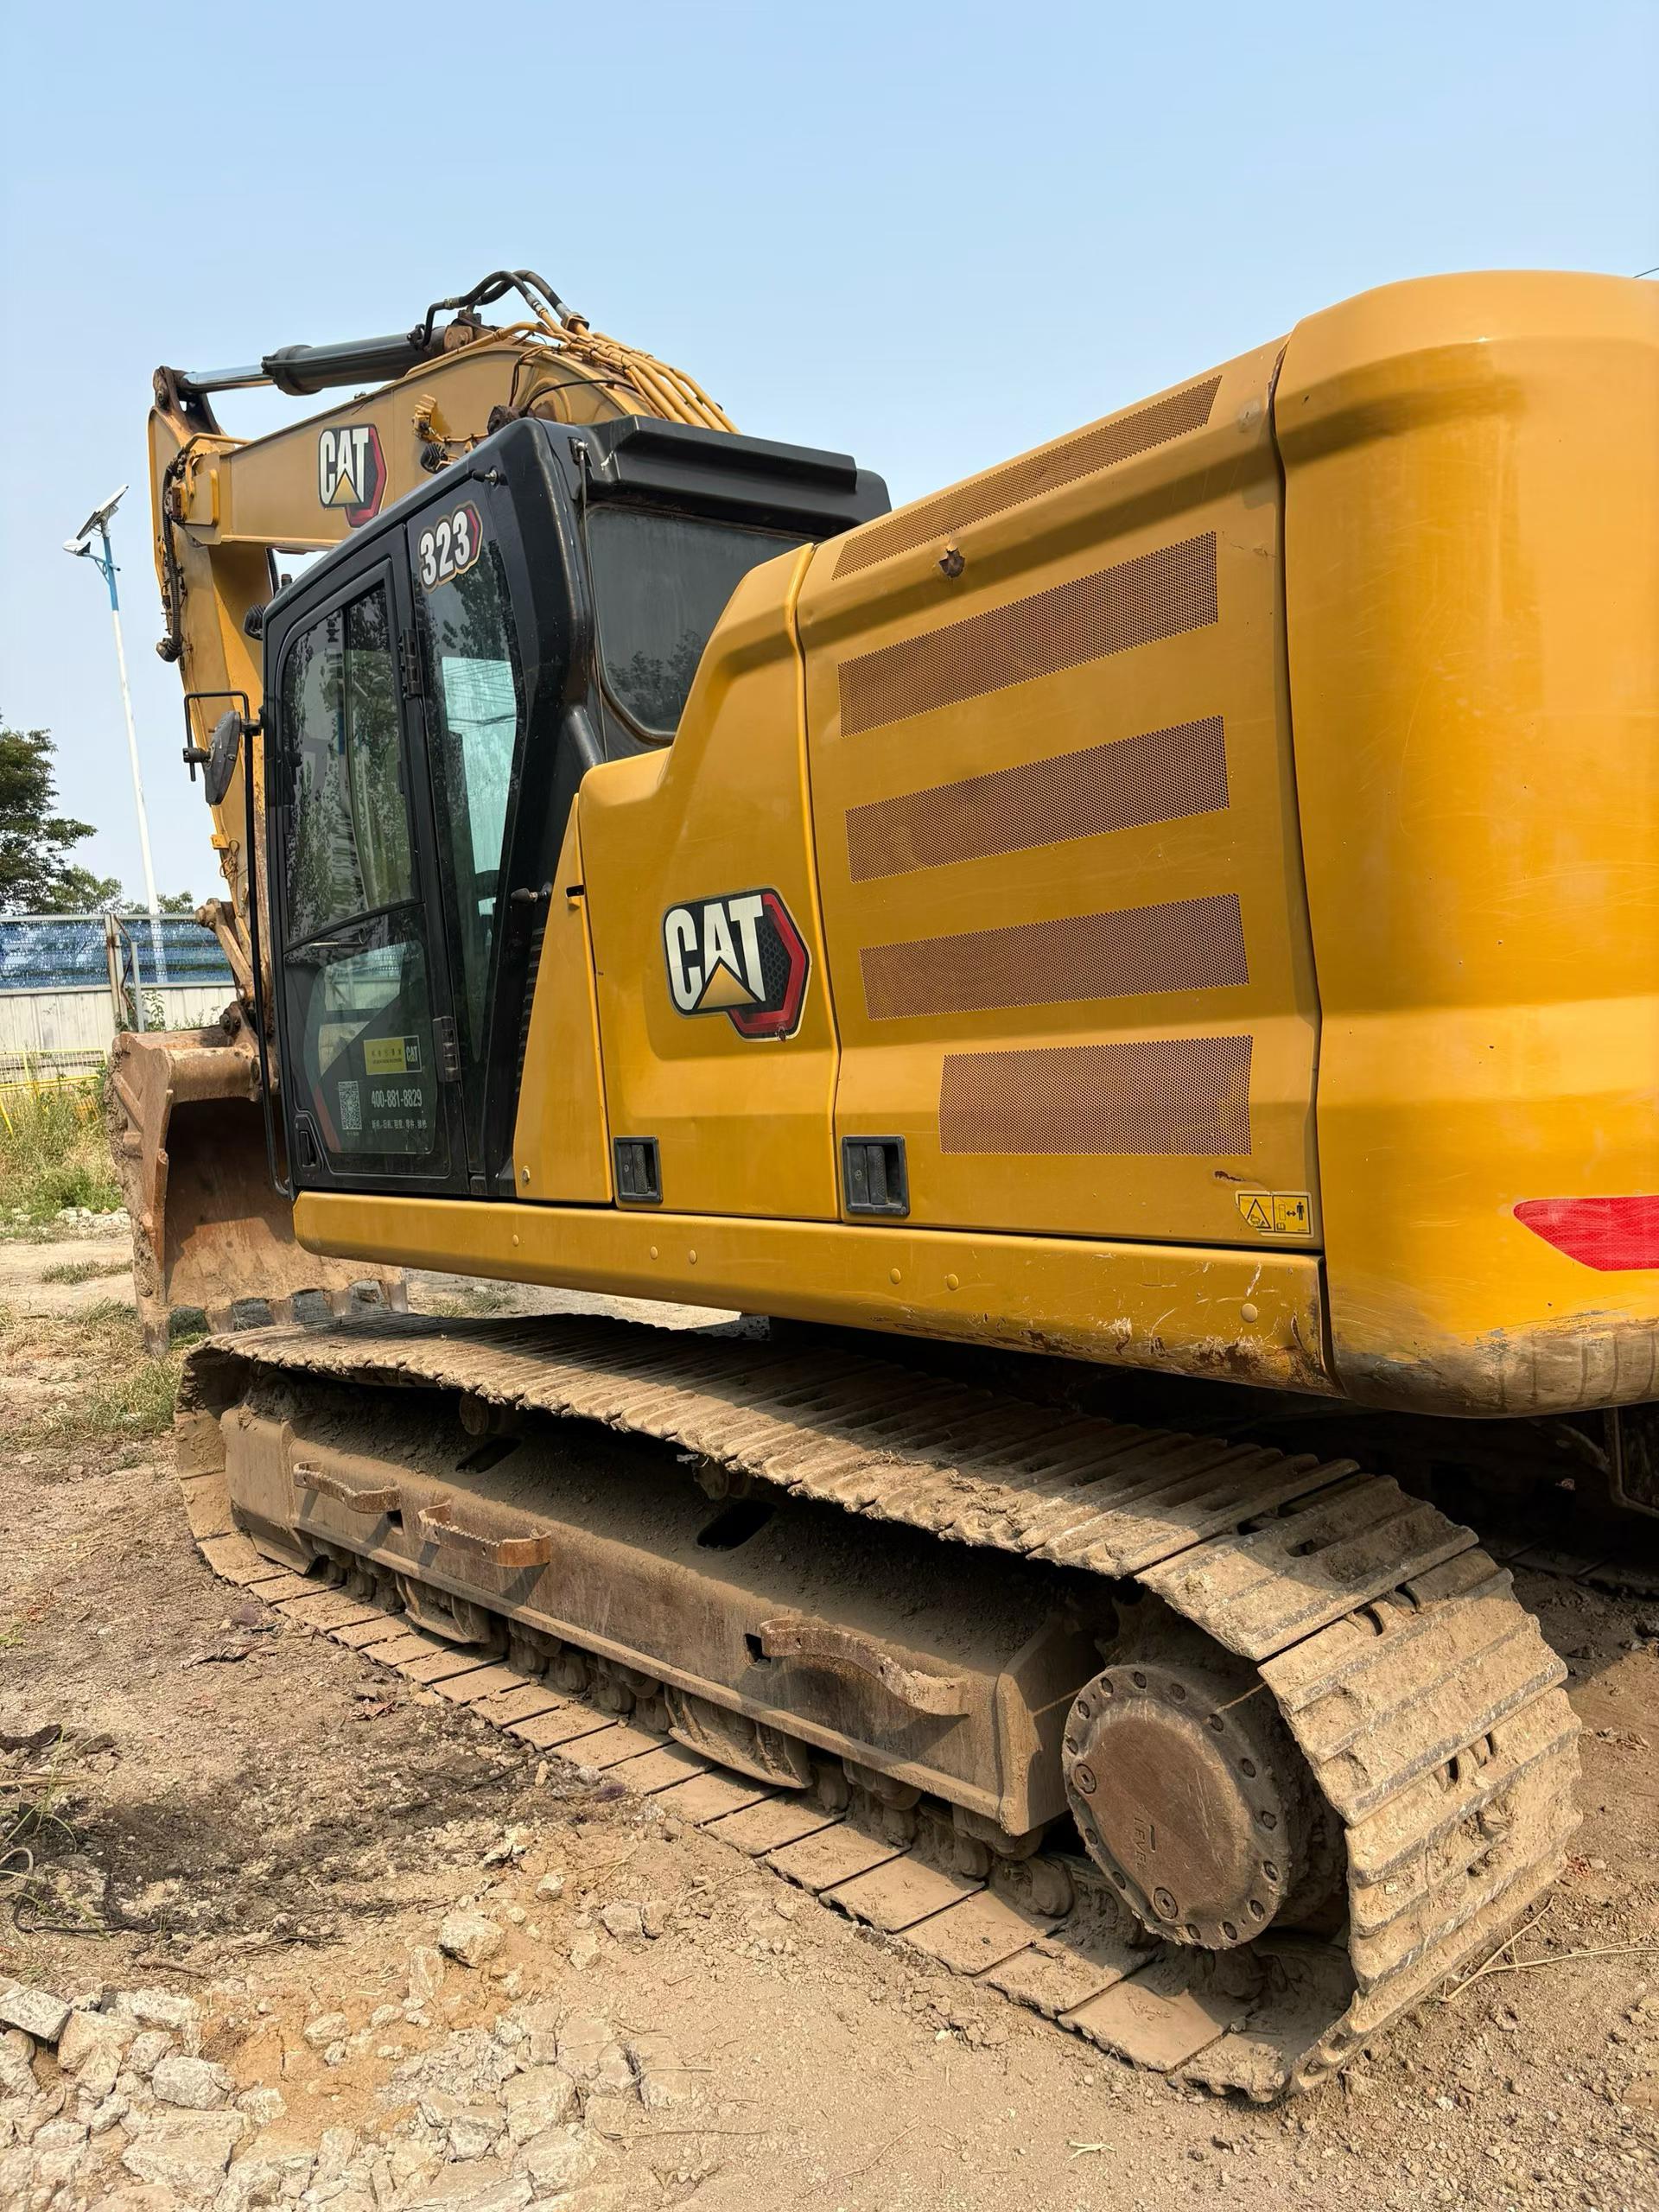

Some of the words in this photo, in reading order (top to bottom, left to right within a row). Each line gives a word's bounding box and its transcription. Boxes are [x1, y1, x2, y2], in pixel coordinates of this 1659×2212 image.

[320, 427, 369, 505] CAT
[420, 511, 470, 585] 323
[664, 894, 766, 1010] CAT
[406, 1046, 418, 1063] CAT
[371, 1088, 423, 1109] 400-881-8829
